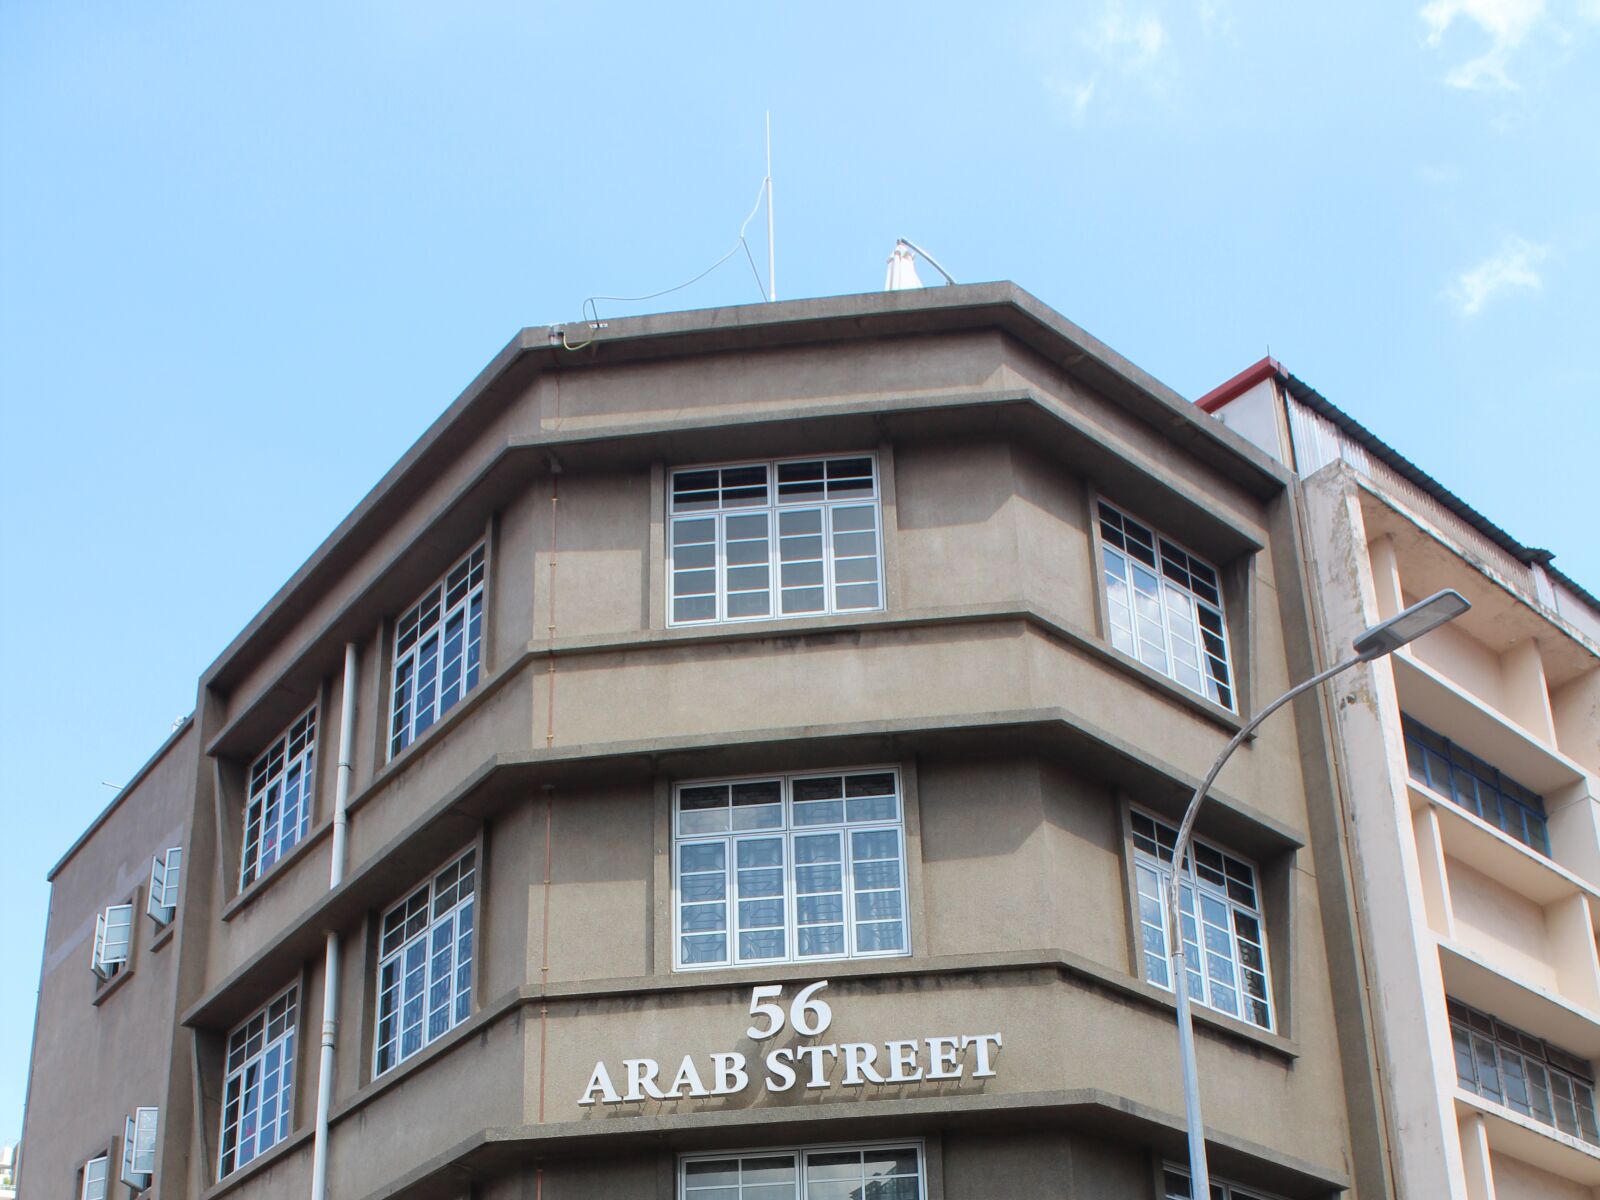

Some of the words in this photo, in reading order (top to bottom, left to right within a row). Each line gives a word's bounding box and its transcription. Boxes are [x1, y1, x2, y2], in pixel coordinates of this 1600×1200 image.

[746, 980, 832, 1040] 56
[577, 1052, 749, 1106] ARAB
[765, 1032, 1003, 1092] STREET
